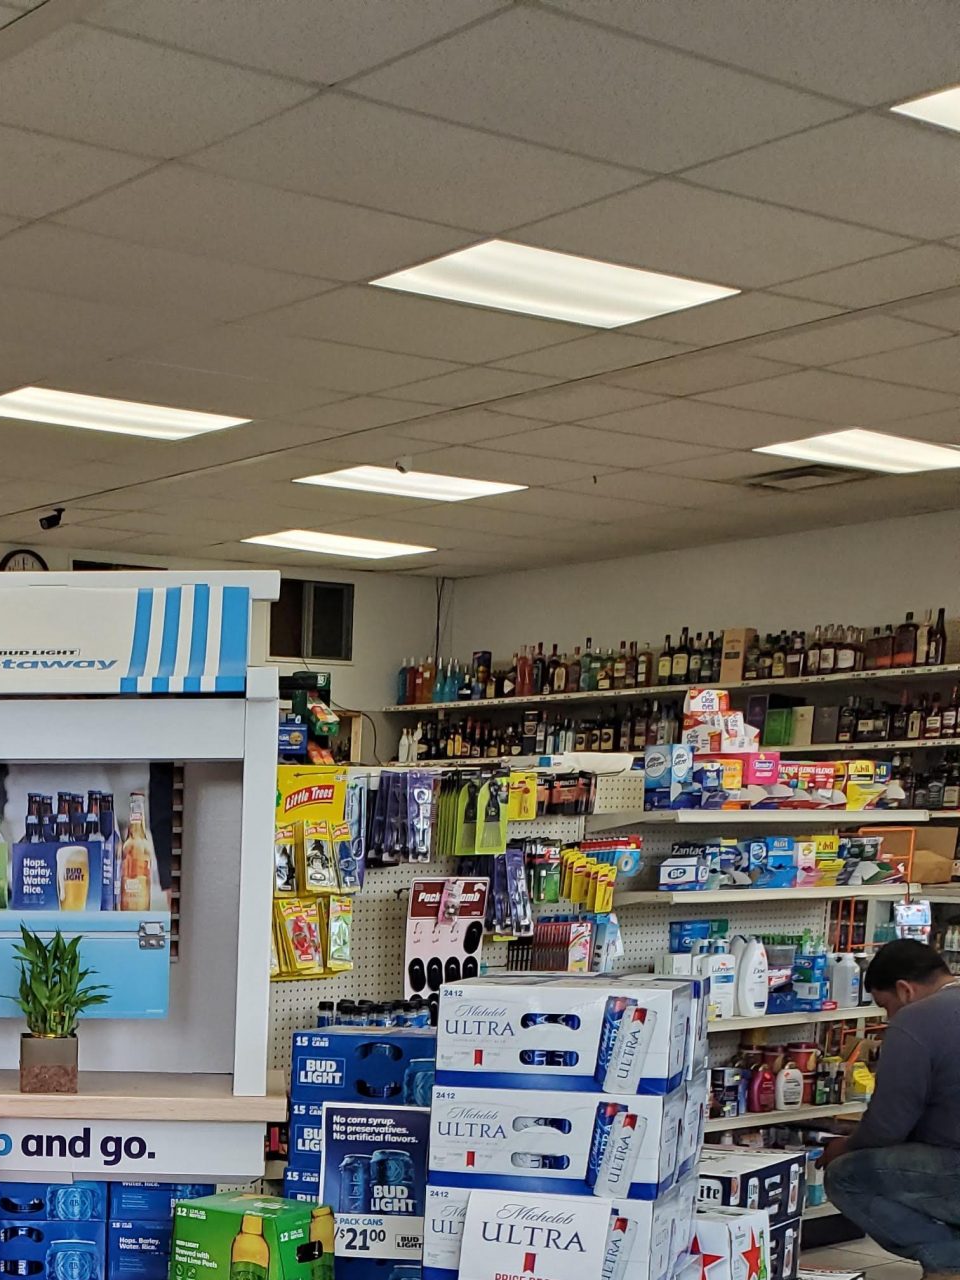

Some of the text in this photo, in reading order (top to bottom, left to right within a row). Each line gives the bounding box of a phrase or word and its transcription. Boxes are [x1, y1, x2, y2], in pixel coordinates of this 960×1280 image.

[32, 648, 78, 656] LIGHT
[701, 695, 715, 704] Clear
[702, 703, 714, 711] eyes
[286, 787, 333, 809] Little Trees
[672, 844, 704, 855] Zantac
[23, 858, 47, 869] Hops.
[23, 867, 52, 878] Barley.
[670, 869, 685, 878] BC
[23, 876, 52, 885] Water.
[23, 885, 44, 894] Rice.
[454, 1004, 506, 1018] Michelob
[445, 1020, 515, 1036] ULTRA
[296, 1036, 309, 1046] 15
[617, 1029, 640, 1079] ULTRA
[305, 1059, 337, 1072] BUD
[300, 1071, 342, 1084] LIGHT
[447, 1106, 498, 1120] Michelob
[333, 1115, 395, 1127] No corn syrup.
[333, 1124, 409, 1135] No preservatives.
[438, 1121, 508, 1139] ULTRA
[347, 1133, 384, 1142] artificial
[385, 1134, 418, 1143] flavors.
[21, 1127, 91, 1160] and
[100, 1135, 156, 1165] go.
[608, 1135, 631, 1183] ULTRA
[373, 1186, 409, 1198] BUD
[371, 1198, 416, 1212] LIGHT
[176, 1207, 187, 1216] 12
[496, 1203, 577, 1225] Michelob
[363, 1218, 383, 1226] CANS
[482, 1221, 587, 1252] ULTRA
[397, 1241, 423, 1249] LIGHT
